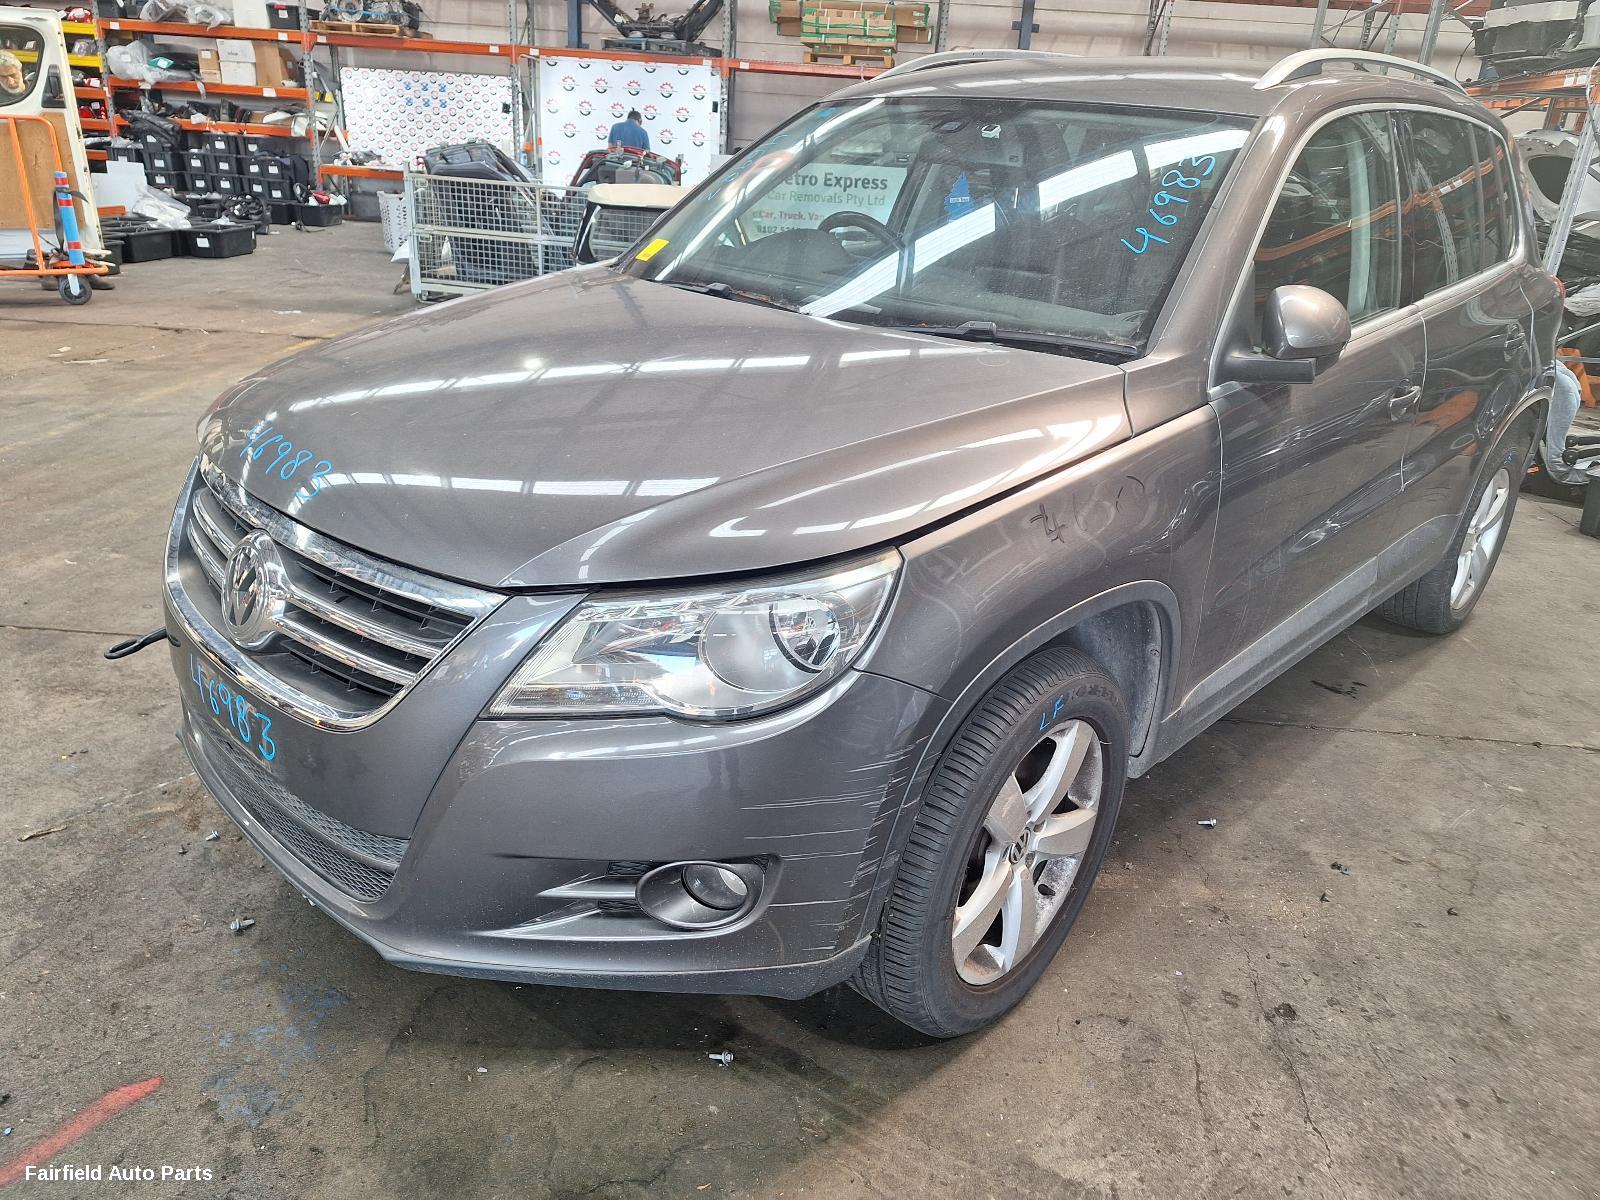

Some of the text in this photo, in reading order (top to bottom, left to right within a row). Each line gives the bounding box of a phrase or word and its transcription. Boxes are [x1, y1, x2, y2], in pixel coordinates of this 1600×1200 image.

[768, 190, 886, 207] Car Removals Pty Ltd
[782, 171, 888, 192] etro Express
[1120, 154, 1216, 254] 46983
[240, 422, 333, 501] 46983
[190, 654, 276, 761] 46983
